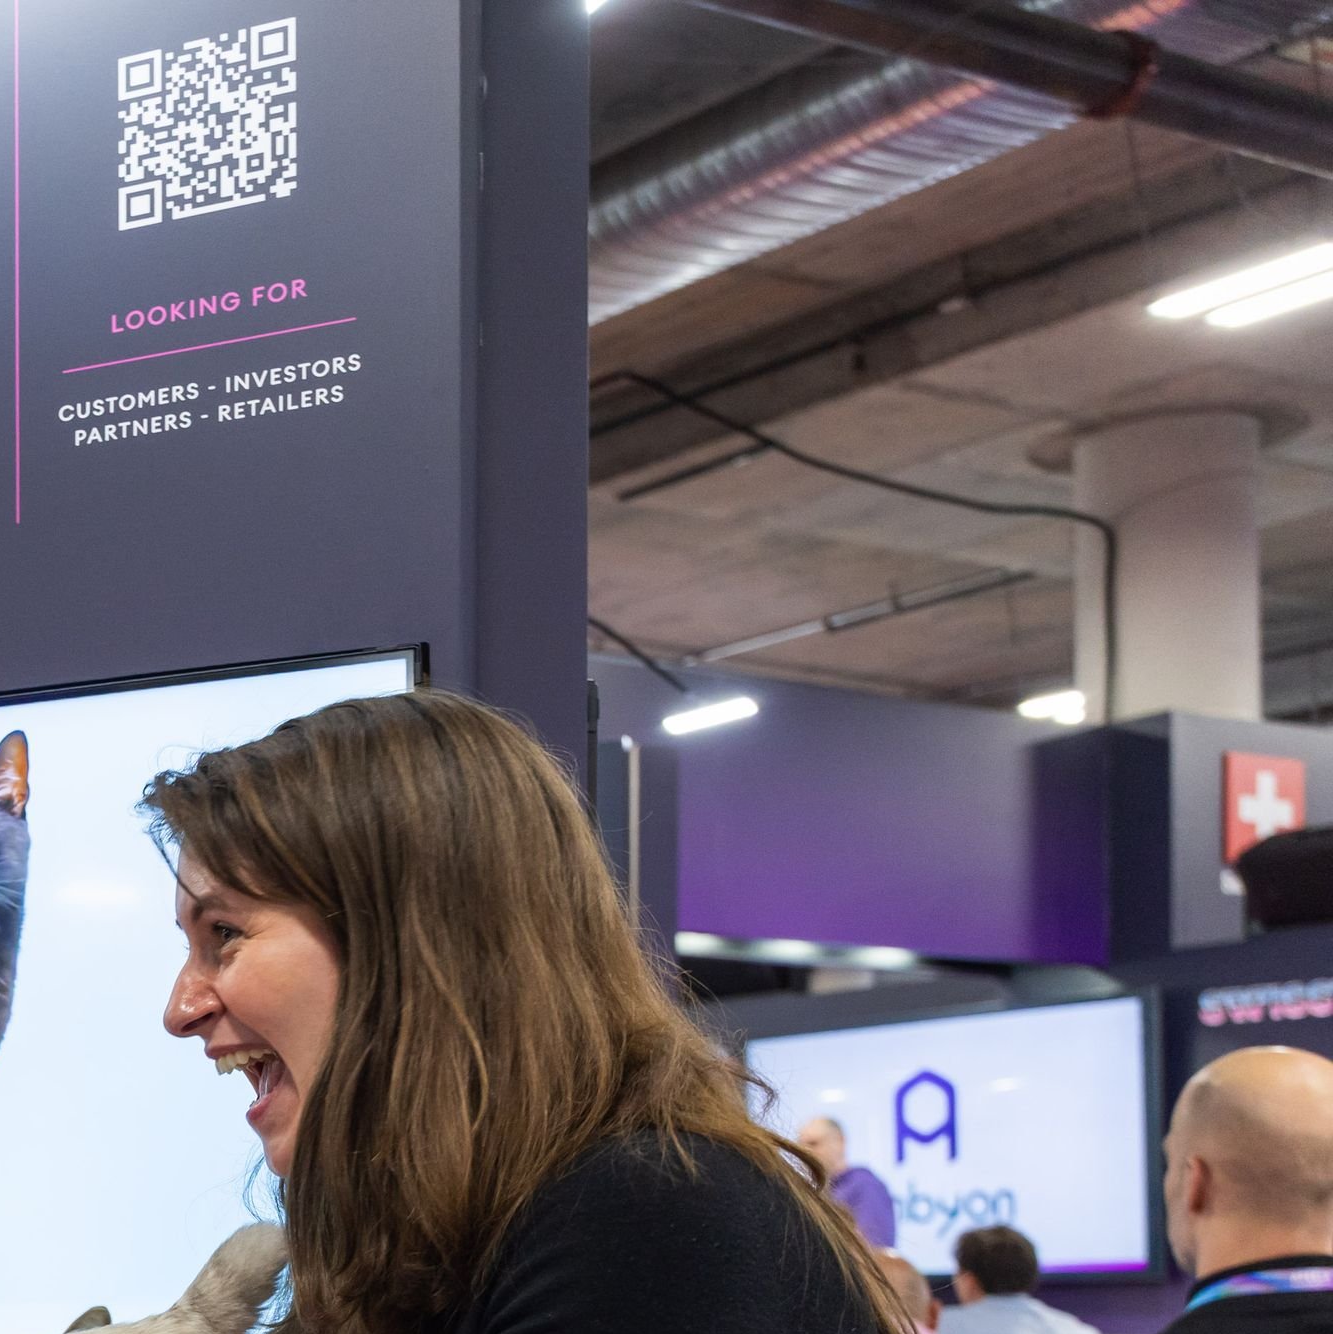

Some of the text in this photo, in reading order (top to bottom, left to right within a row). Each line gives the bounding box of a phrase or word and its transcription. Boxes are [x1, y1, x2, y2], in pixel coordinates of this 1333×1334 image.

[110, 278, 308, 334] LOOKING FOR
[57, 382, 200, 423] CUSTOMERS
[224, 352, 362, 394] INVESTORS
[73, 410, 193, 448] PARTNERS
[217, 384, 345, 423] RETAILERS
